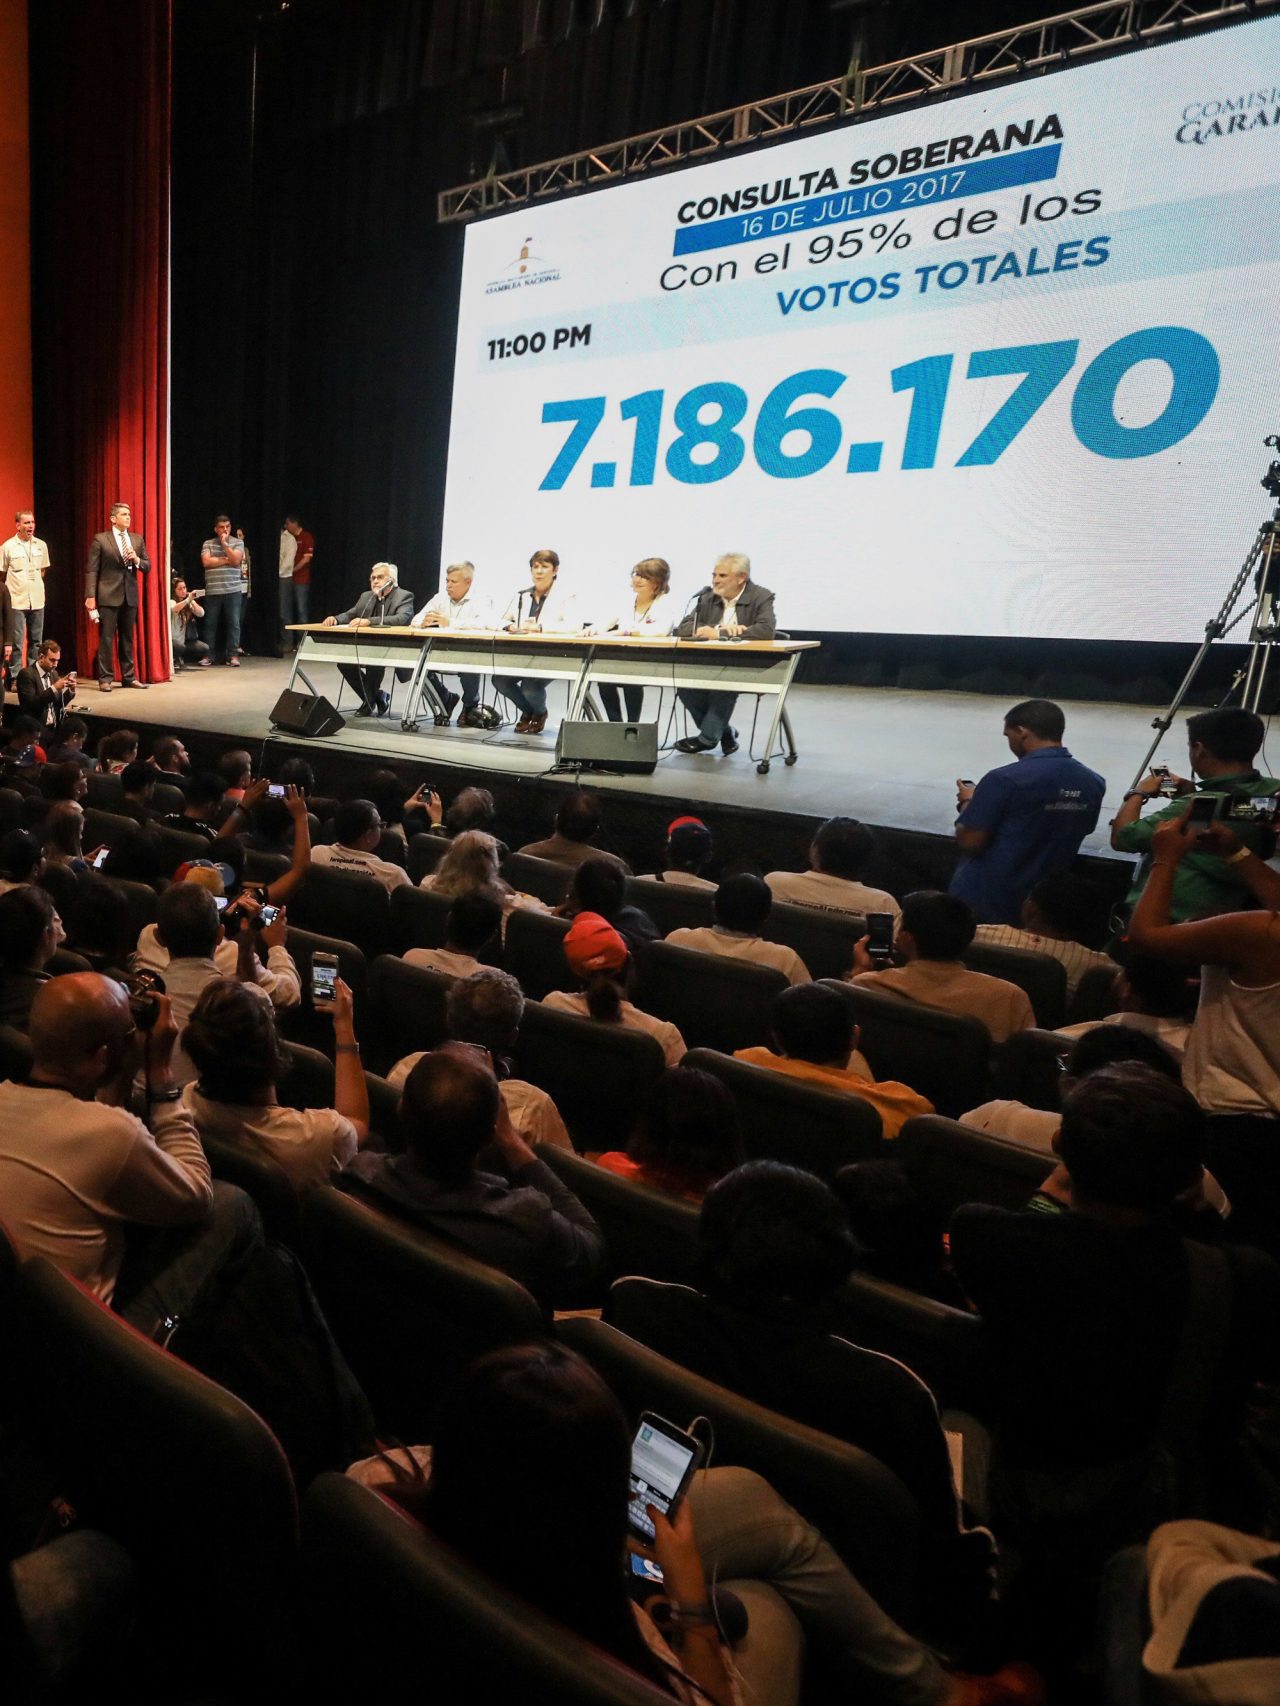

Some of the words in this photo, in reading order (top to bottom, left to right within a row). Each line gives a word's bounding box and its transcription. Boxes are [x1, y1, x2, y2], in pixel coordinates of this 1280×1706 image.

[1181, 86, 1280, 121] COMISI
[677, 167, 839, 224] CONSULTA
[848, 113, 1064, 185] SOBERANA
[741, 215, 764, 238] 16
[770, 206, 807, 231] DE
[812, 188, 893, 222] JULIO
[899, 170, 967, 204] 2017
[659, 260, 738, 291] Con
[754, 242, 790, 274] el
[808, 218, 912, 264] 95%
[933, 207, 998, 241] de
[1019, 188, 1102, 226] los
[776, 272, 901, 316] VOTOS
[915, 235, 1112, 293] TOTALES
[485, 281, 521, 295] ASAMBLEA
[524, 273, 562, 287] NACIONAL
[487, 331, 546, 361] 11:00
[553, 323, 593, 351] PM
[537, 325, 1222, 492] 7.186.170
